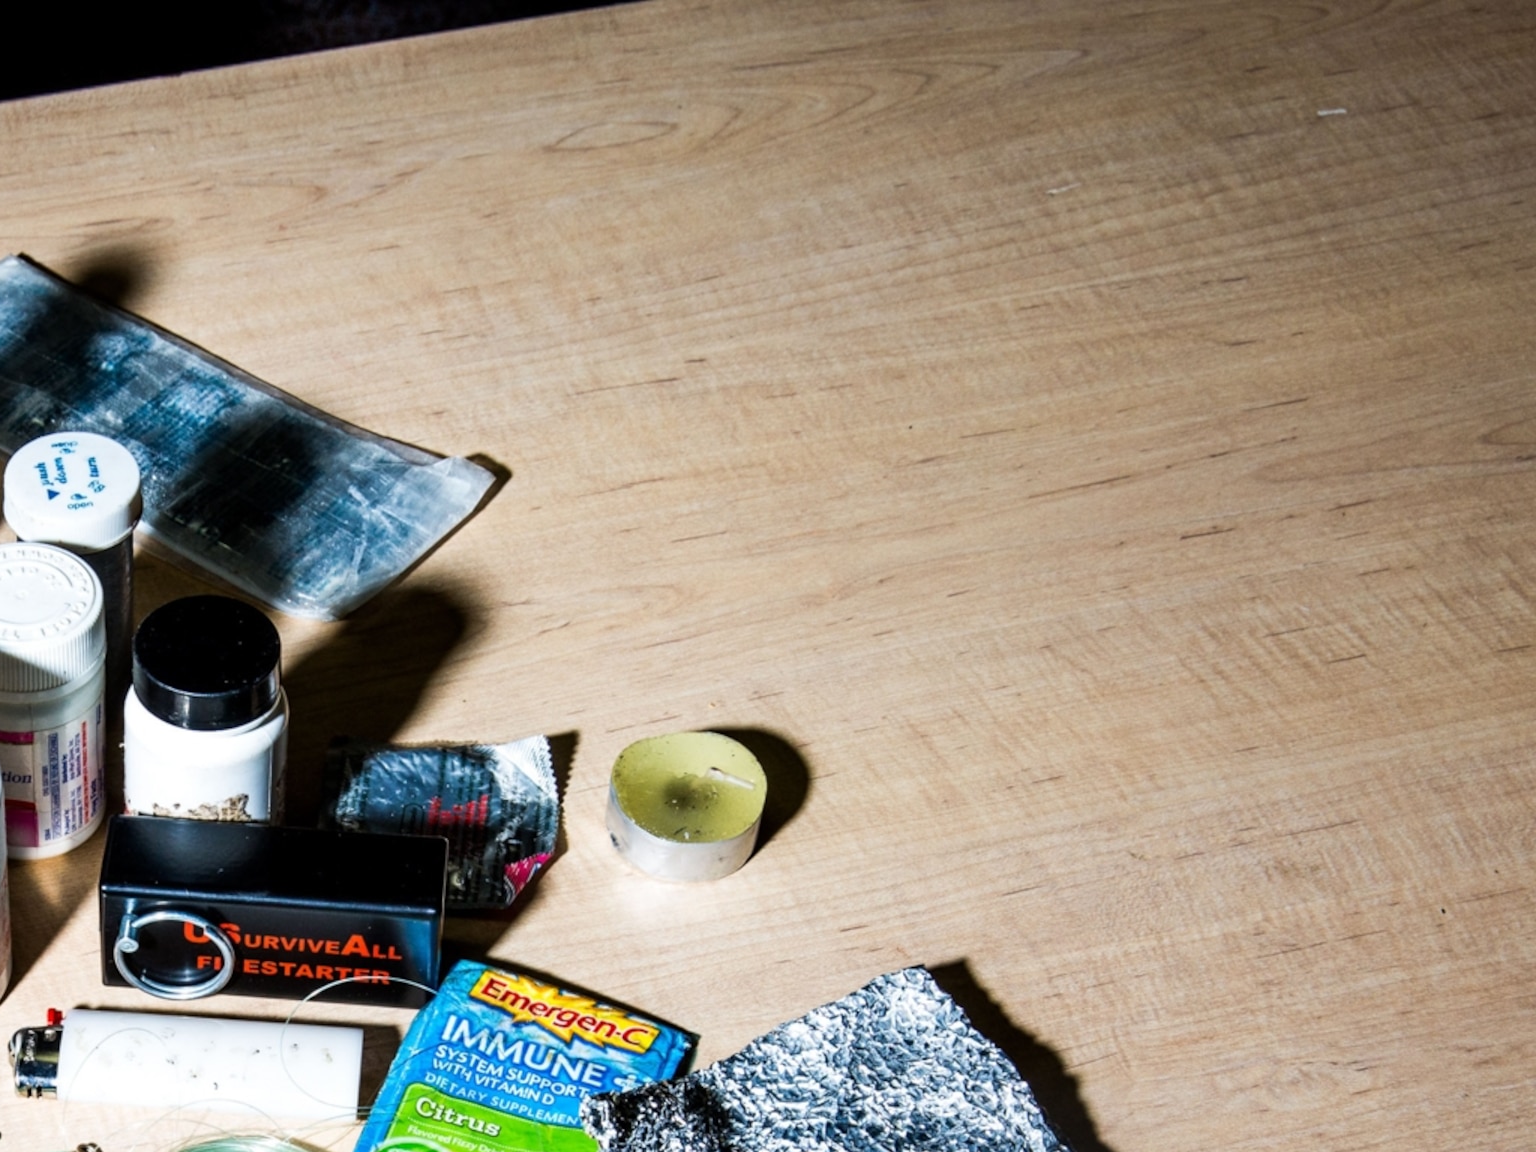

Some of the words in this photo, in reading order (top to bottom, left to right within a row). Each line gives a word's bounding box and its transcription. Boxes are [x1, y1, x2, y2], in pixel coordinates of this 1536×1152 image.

[34, 462, 54, 486] push
[54, 457, 67, 484] down
[88, 457, 99, 477] turn
[67, 501, 93, 510] open
[196, 955, 390, 985] FIESTARTER
[481, 977, 651, 1046] Emergen-C
[431, 1058, 473, 1080] WITH
[473, 1069, 542, 1104] VITAMIN
[541, 1091, 555, 1106] D
[434, 1044, 504, 1078] SYSTEM
[505, 1068, 592, 1099] SUPPORT
[424, 1071, 488, 1103] DIETARY
[490, 1096, 581, 1126] SUPPLEMEN
[415, 1096, 502, 1138] Citrus
[407, 1124, 452, 1145] Flavored
[451, 1137, 478, 1152] Fizzy
